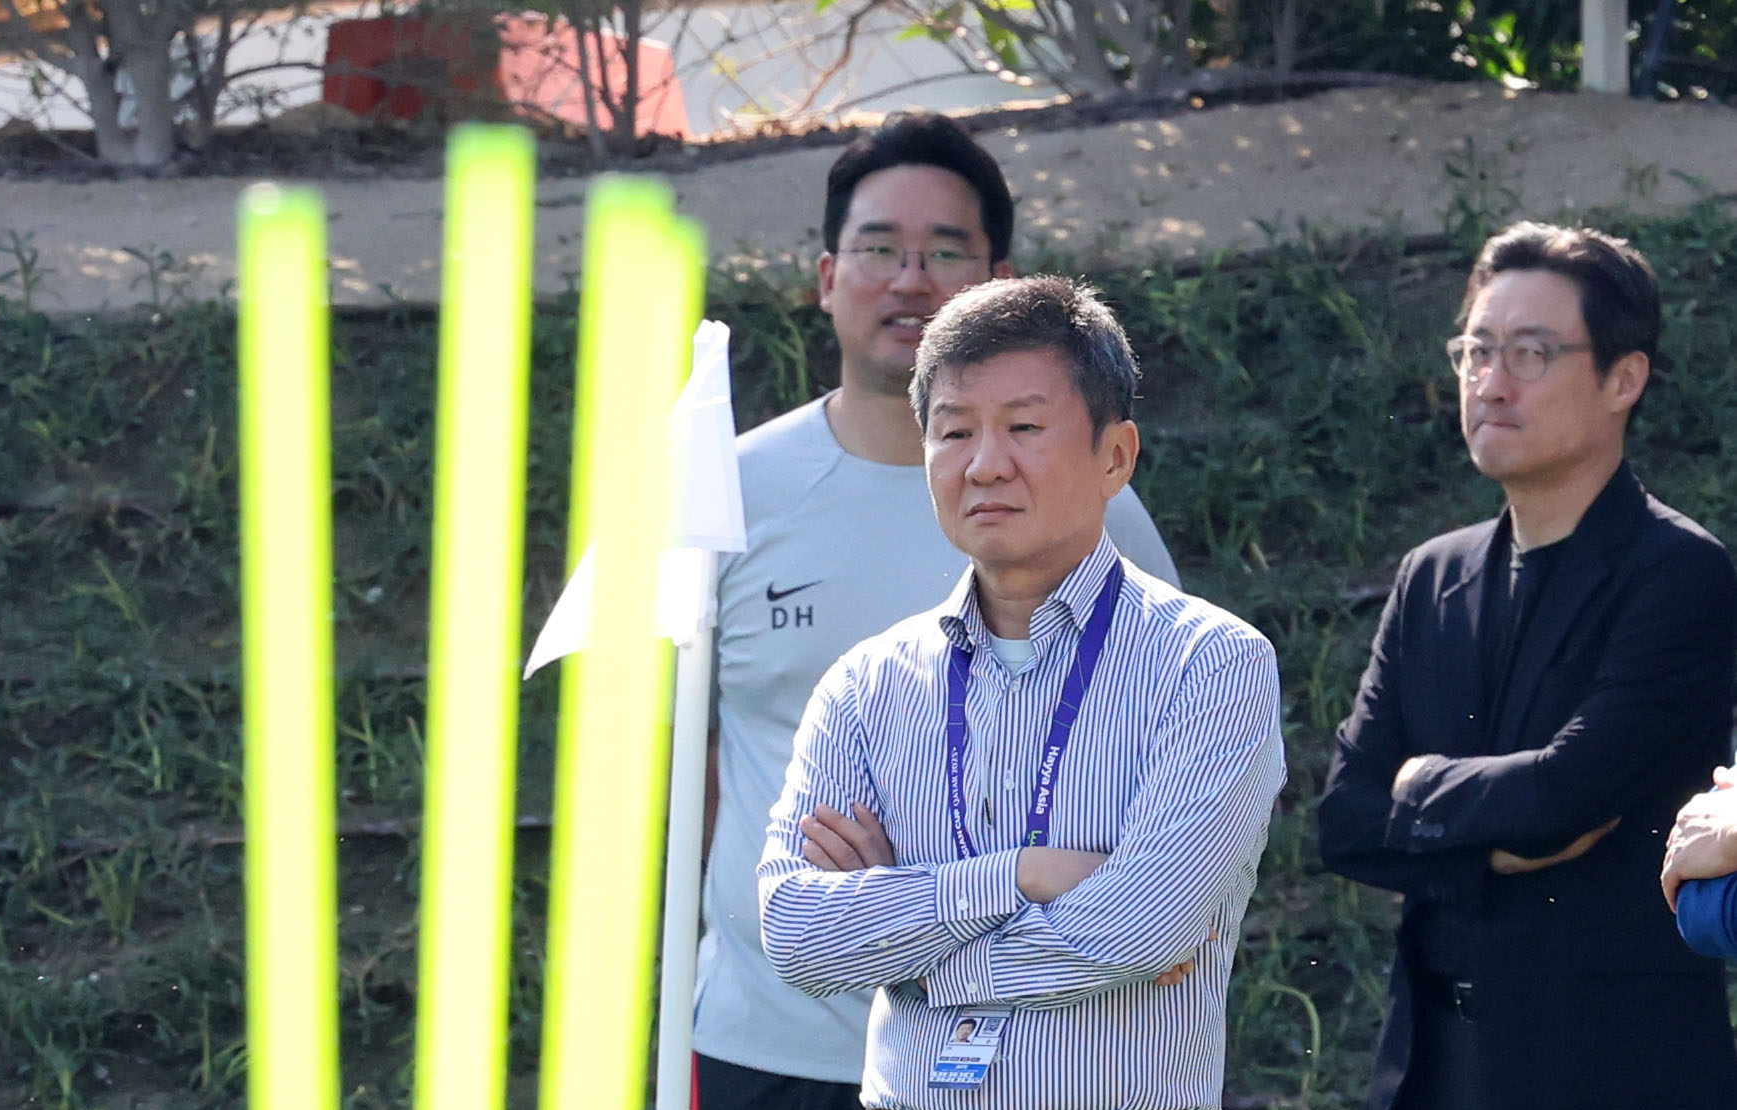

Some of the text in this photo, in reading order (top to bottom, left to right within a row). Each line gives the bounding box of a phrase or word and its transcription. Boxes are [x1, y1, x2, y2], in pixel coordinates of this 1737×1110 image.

[771, 604, 814, 631] DH
[1035, 745, 1061, 815] Hayya Asia
[953, 808, 962, 830] CUP
